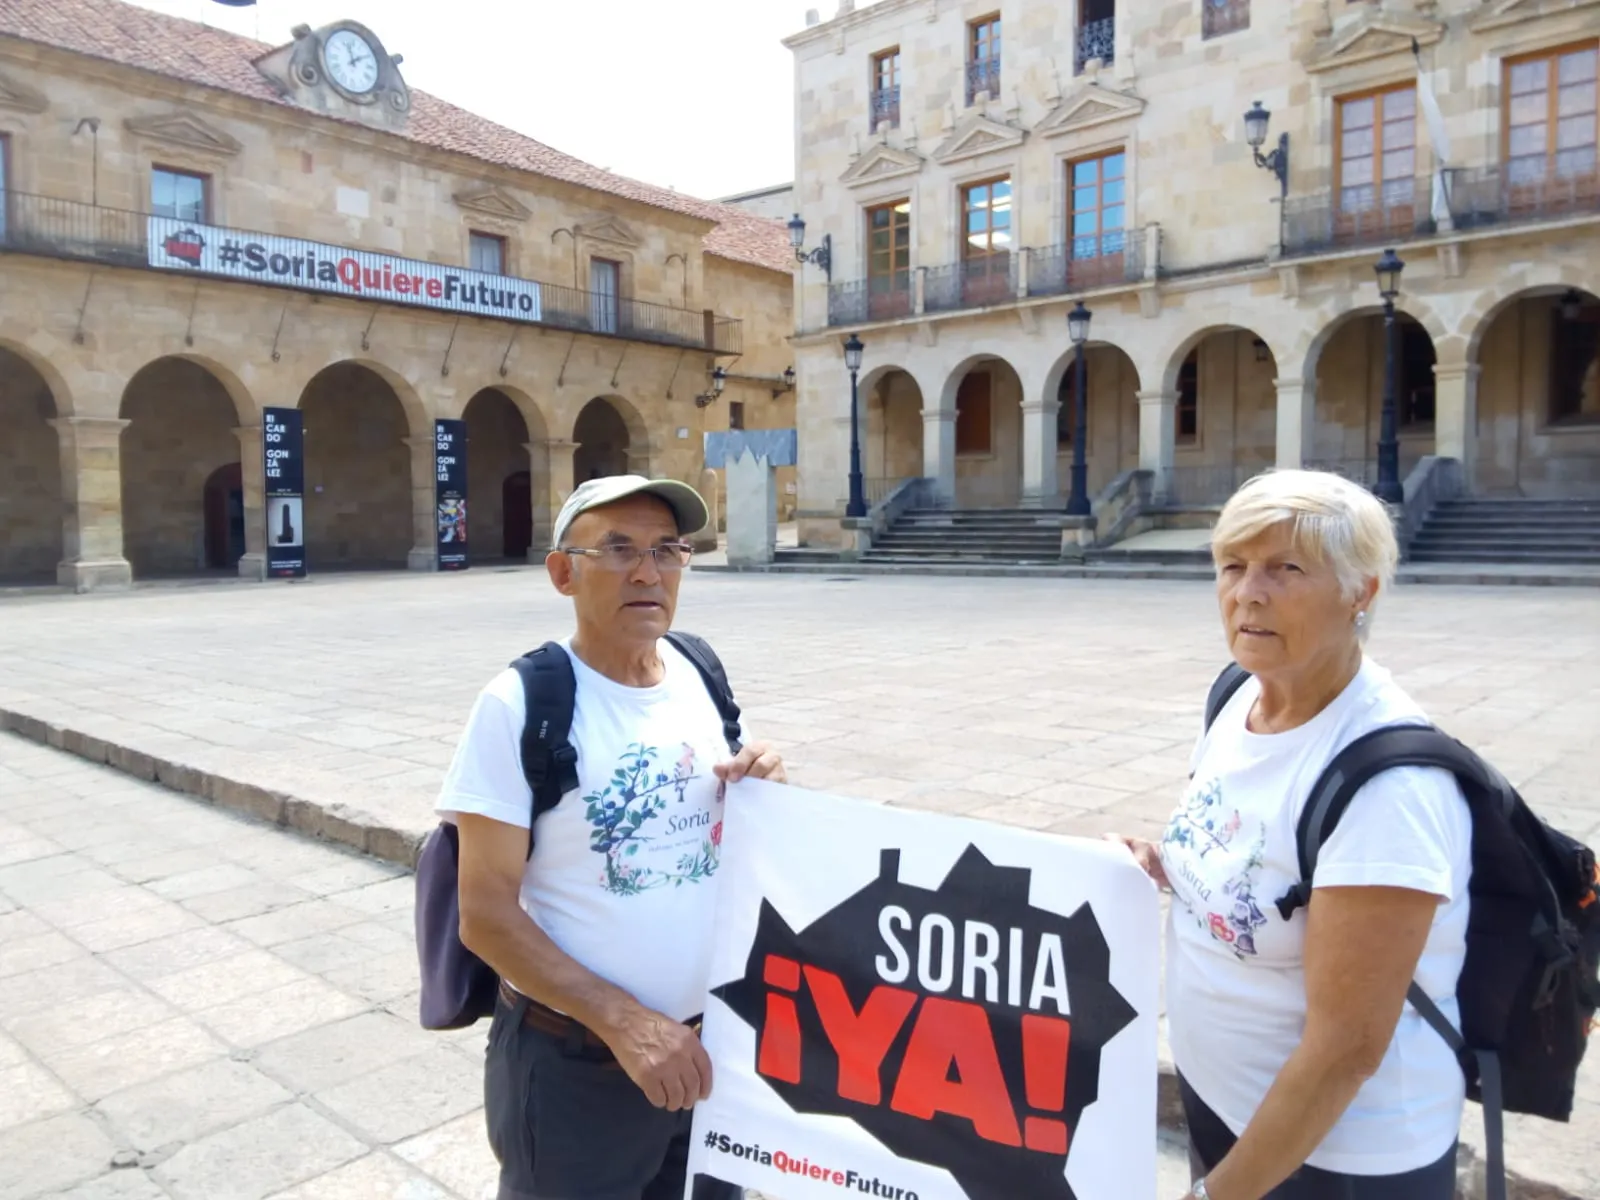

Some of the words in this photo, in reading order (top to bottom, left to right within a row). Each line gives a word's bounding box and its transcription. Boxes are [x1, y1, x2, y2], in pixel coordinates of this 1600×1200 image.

[218, 239, 533, 312] #SoriaQuiereFuturo
[266, 424, 286, 433] CAR
[266, 434, 280, 442] DO
[266, 449, 289, 458] GON
[437, 456, 455, 464] GON
[267, 468, 281, 477] LEZ
[665, 808, 710, 836] Soria
[875, 905, 1071, 1016] SORIA
[758, 954, 1071, 1155] ¡YA!
[704, 1130, 919, 1200] #SoriaQuiereFuturo
